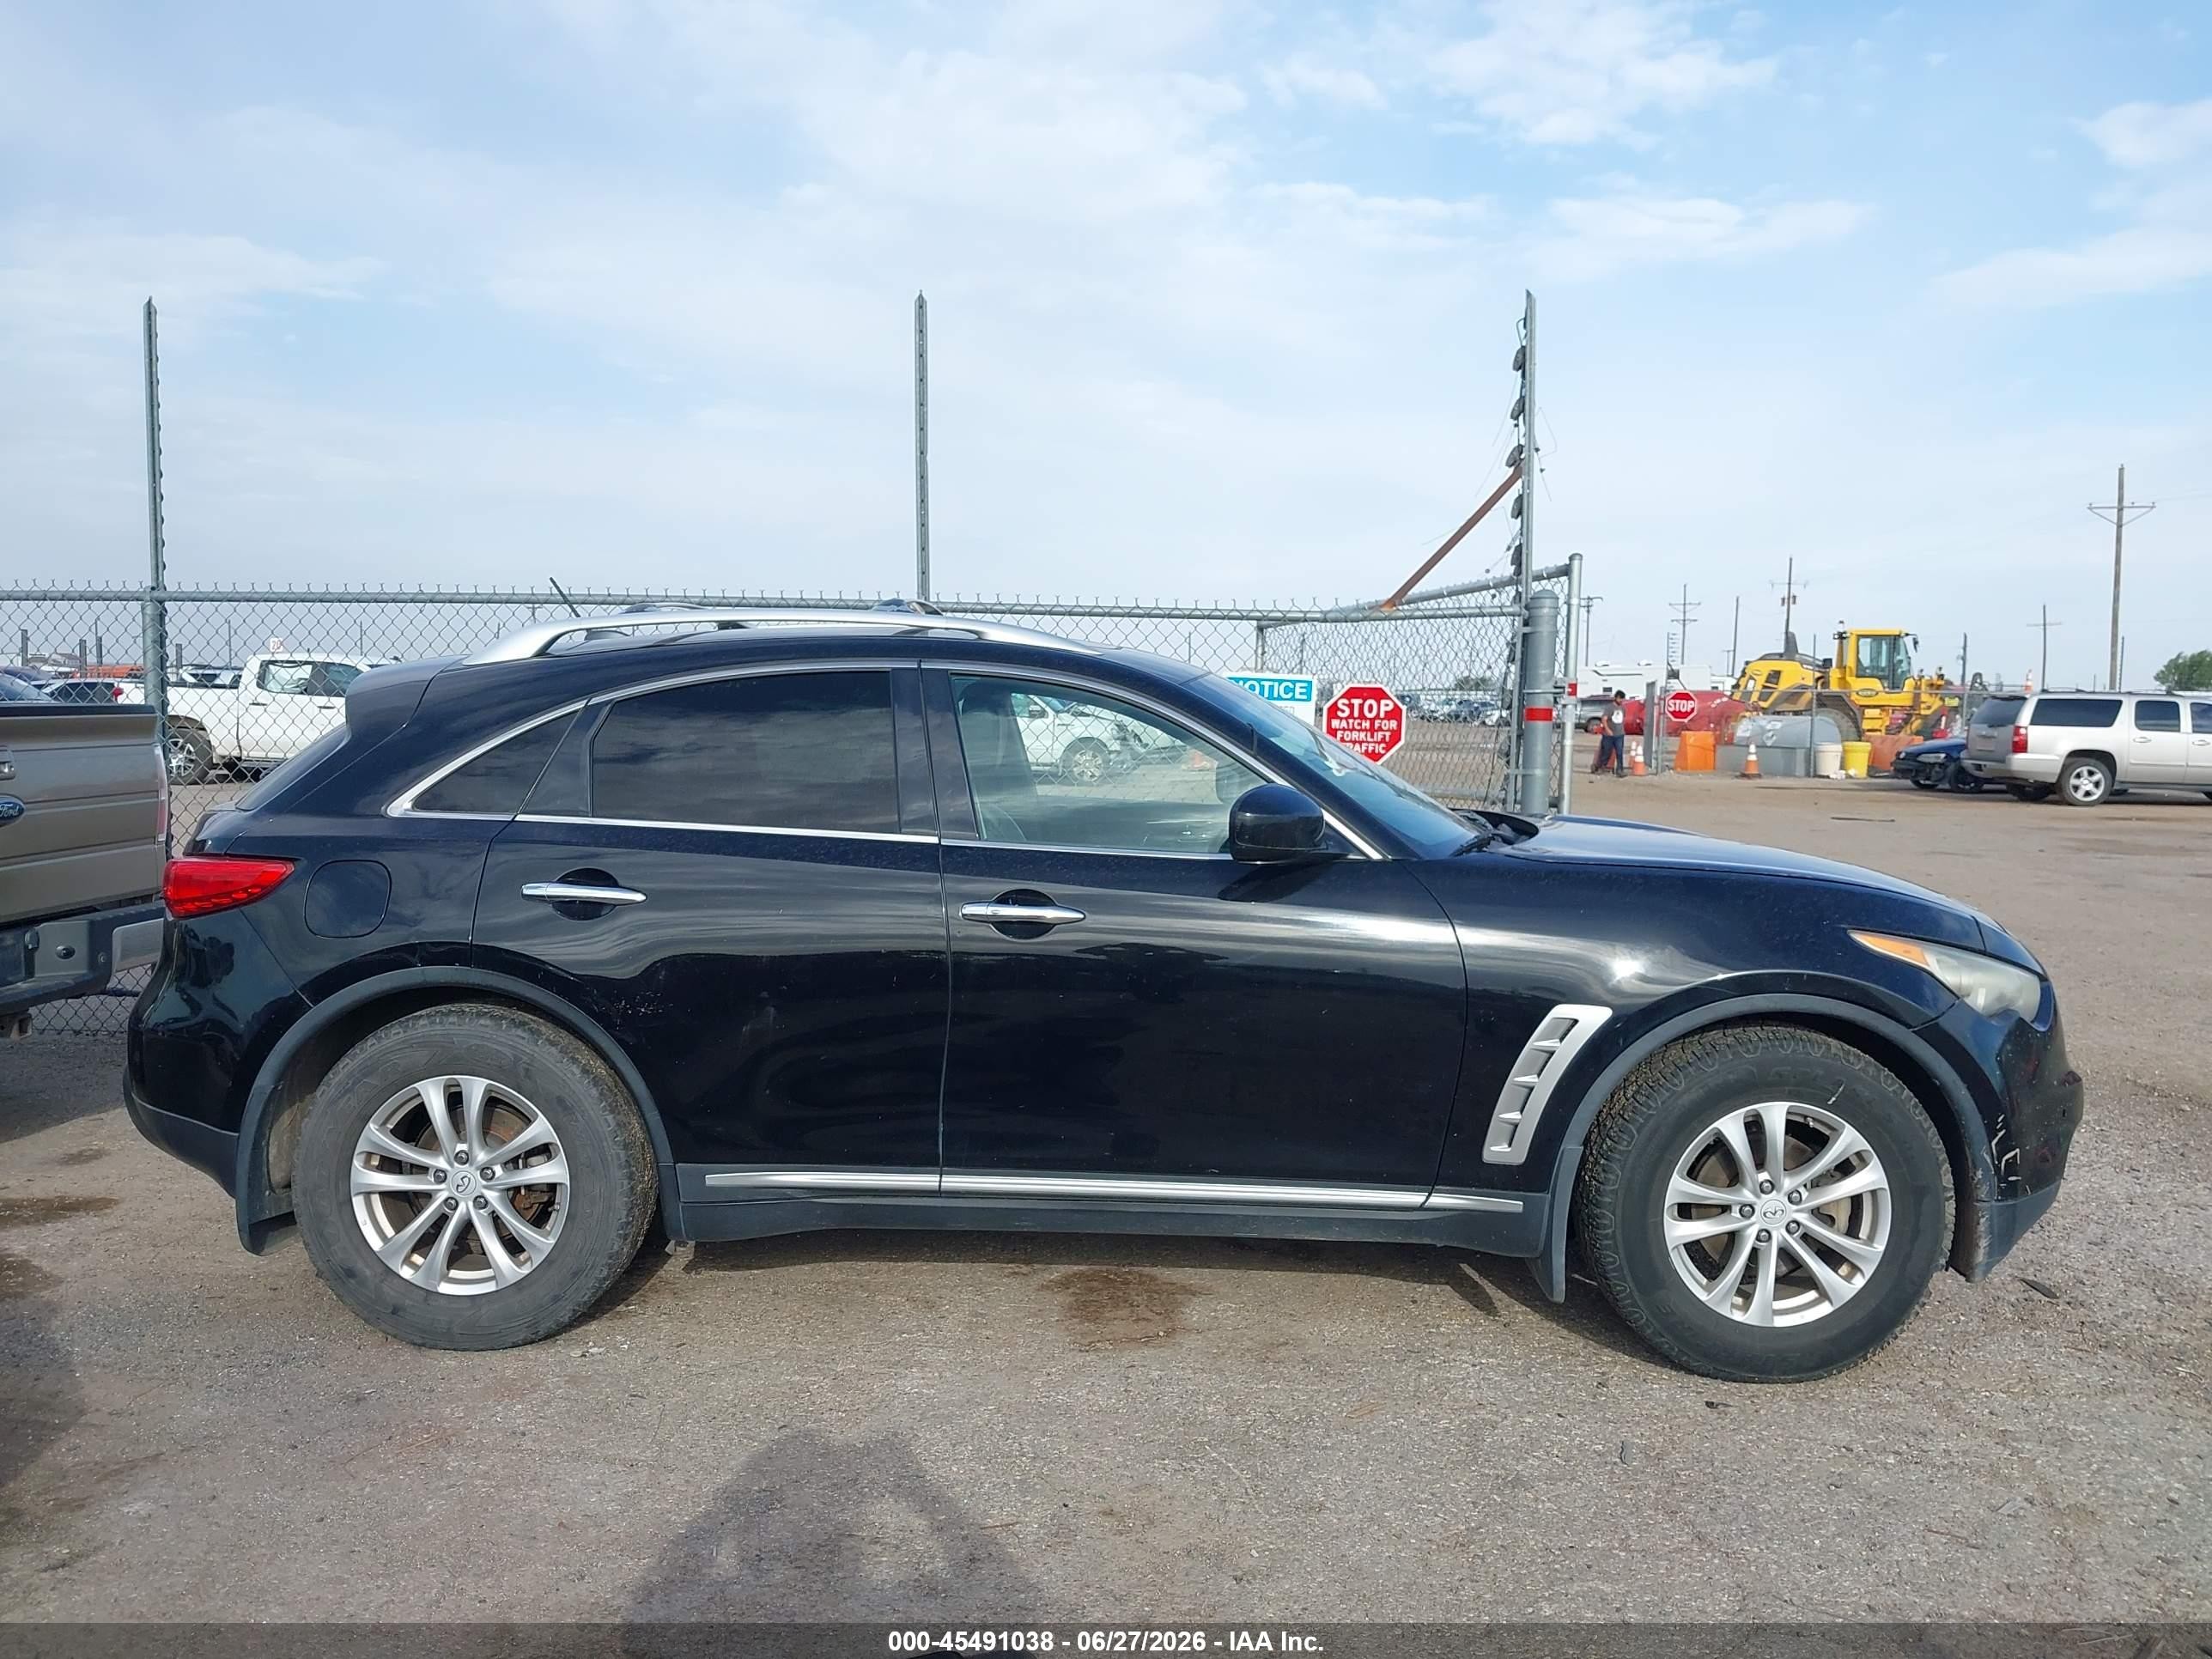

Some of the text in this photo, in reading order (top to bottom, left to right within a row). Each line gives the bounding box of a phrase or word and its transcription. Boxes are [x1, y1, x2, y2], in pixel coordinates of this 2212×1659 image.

[1336, 698, 1395, 719] STOP
[1668, 699, 1695, 713] STOP
[1331, 718, 1398, 731] WATCH FOR
[1336, 730, 1391, 742] FORKLIFT
[1342, 742, 1387, 754] RAFFIC
[0, 803, 20, 817] Ford
